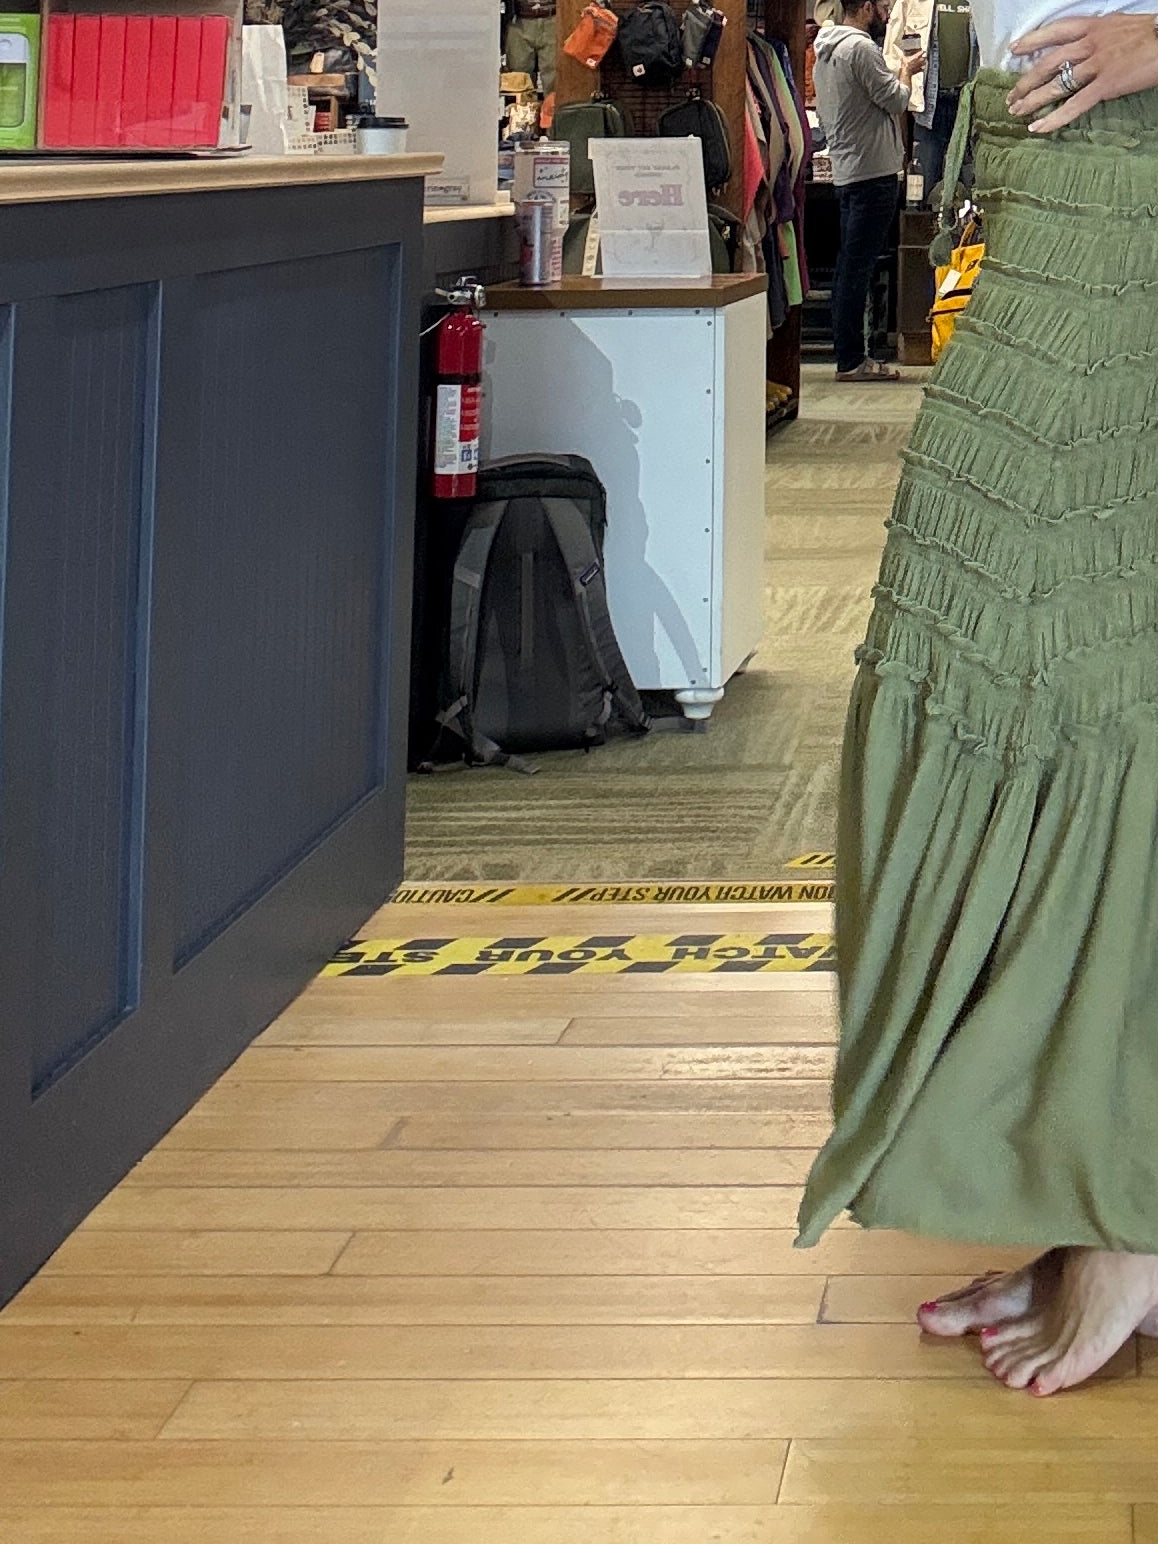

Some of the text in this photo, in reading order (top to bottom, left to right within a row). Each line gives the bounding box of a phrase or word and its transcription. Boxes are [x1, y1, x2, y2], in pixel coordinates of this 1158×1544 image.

[390, 888, 474, 904] CAUTIO
[592, 887, 651, 901] STEP
[652, 886, 711, 901] YOUR
[714, 885, 793, 900] WATCH
[326, 950, 440, 964] STE
[474, 947, 633, 963] YOUR
